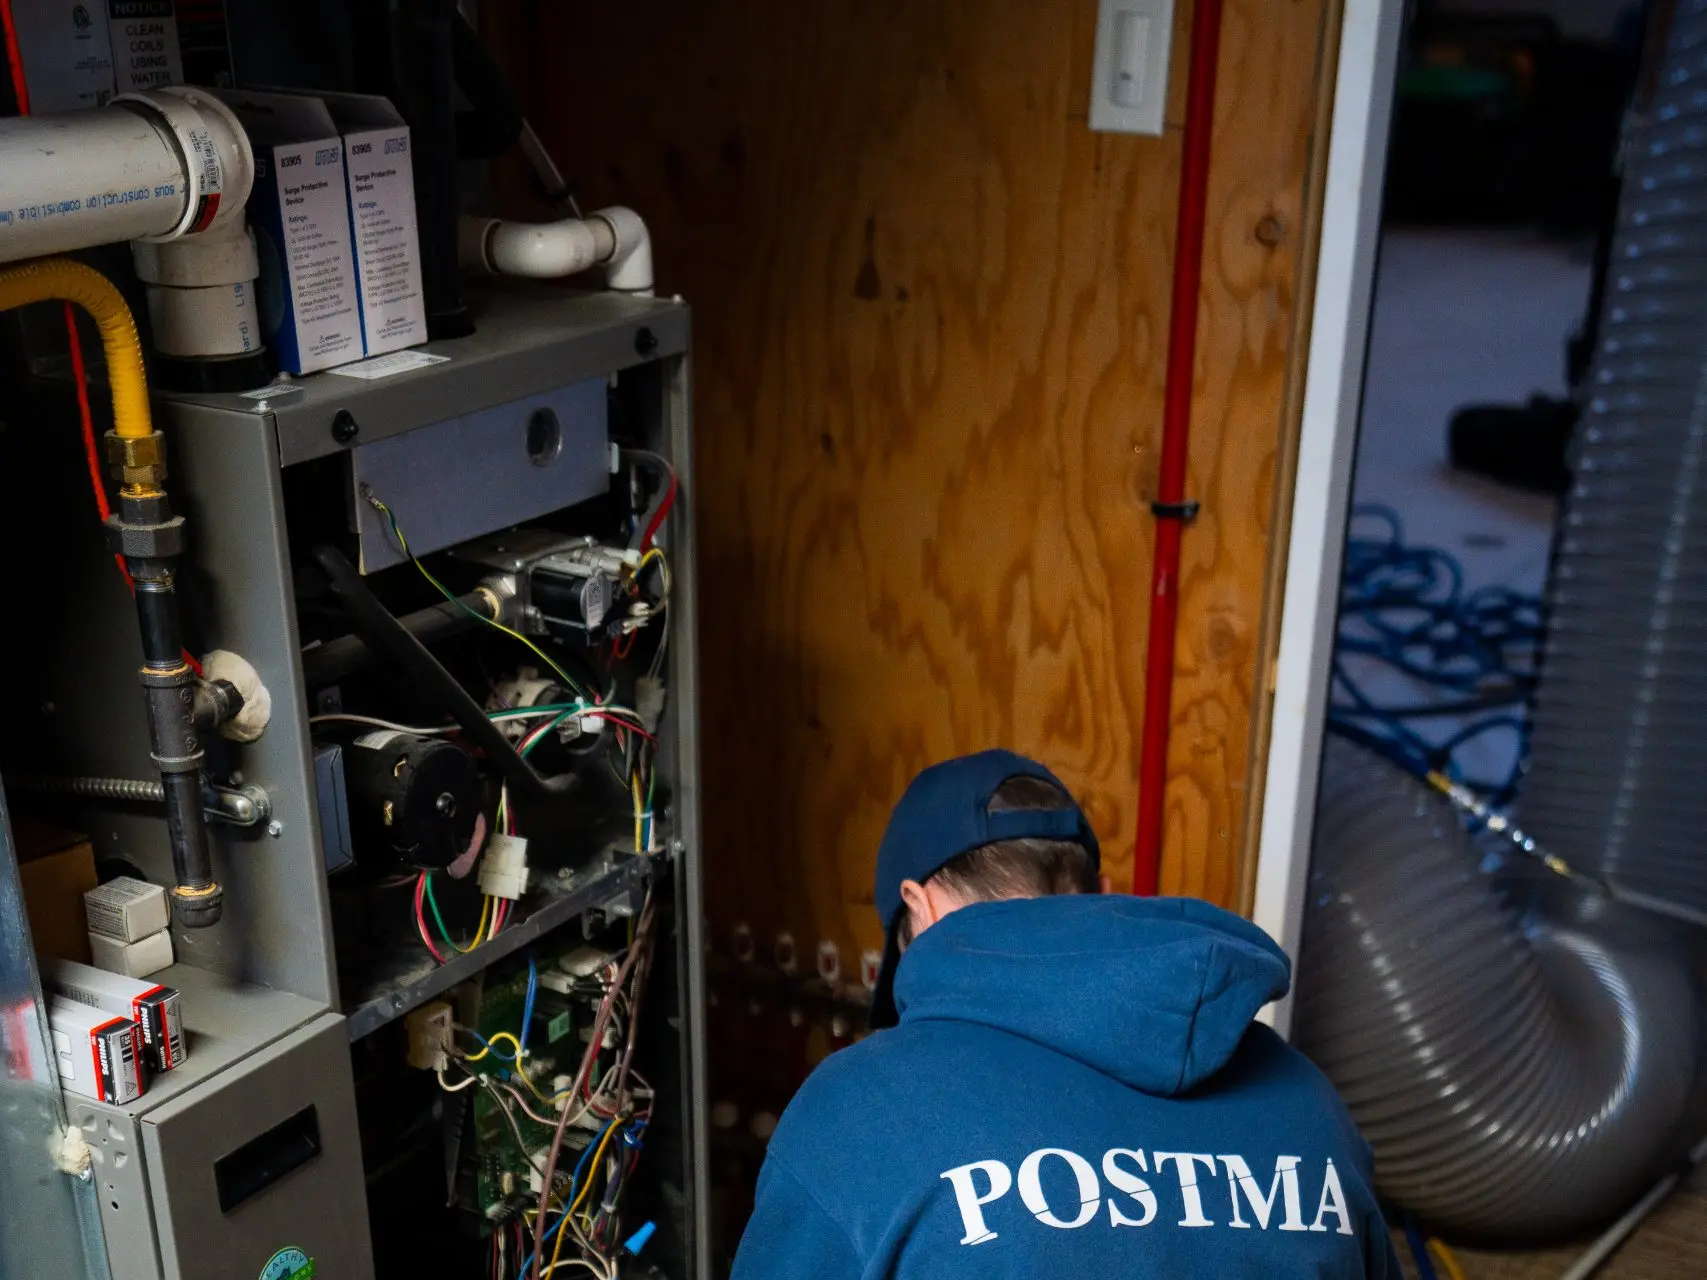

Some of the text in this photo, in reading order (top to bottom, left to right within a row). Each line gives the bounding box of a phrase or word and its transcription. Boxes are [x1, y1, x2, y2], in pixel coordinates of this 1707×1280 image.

[126, 24, 164, 36] CLEAN
[130, 39, 164, 52] COILS
[131, 56, 167, 69] USING
[131, 71, 170, 85] WATER
[280, 155, 302, 168] 83905
[371, 169, 396, 179] Protective
[154, 184, 175, 198] sous
[284, 181, 328, 197] Surge Protective
[356, 184, 374, 192] Device
[87, 188, 150, 209] construction
[286, 197, 304, 206] Device
[19, 200, 81, 223] combustible
[140, 1006, 151, 1044] PHILIPS
[98, 1037, 109, 1076] PHILIPS
[940, 1148, 1354, 1246] POSTMA
